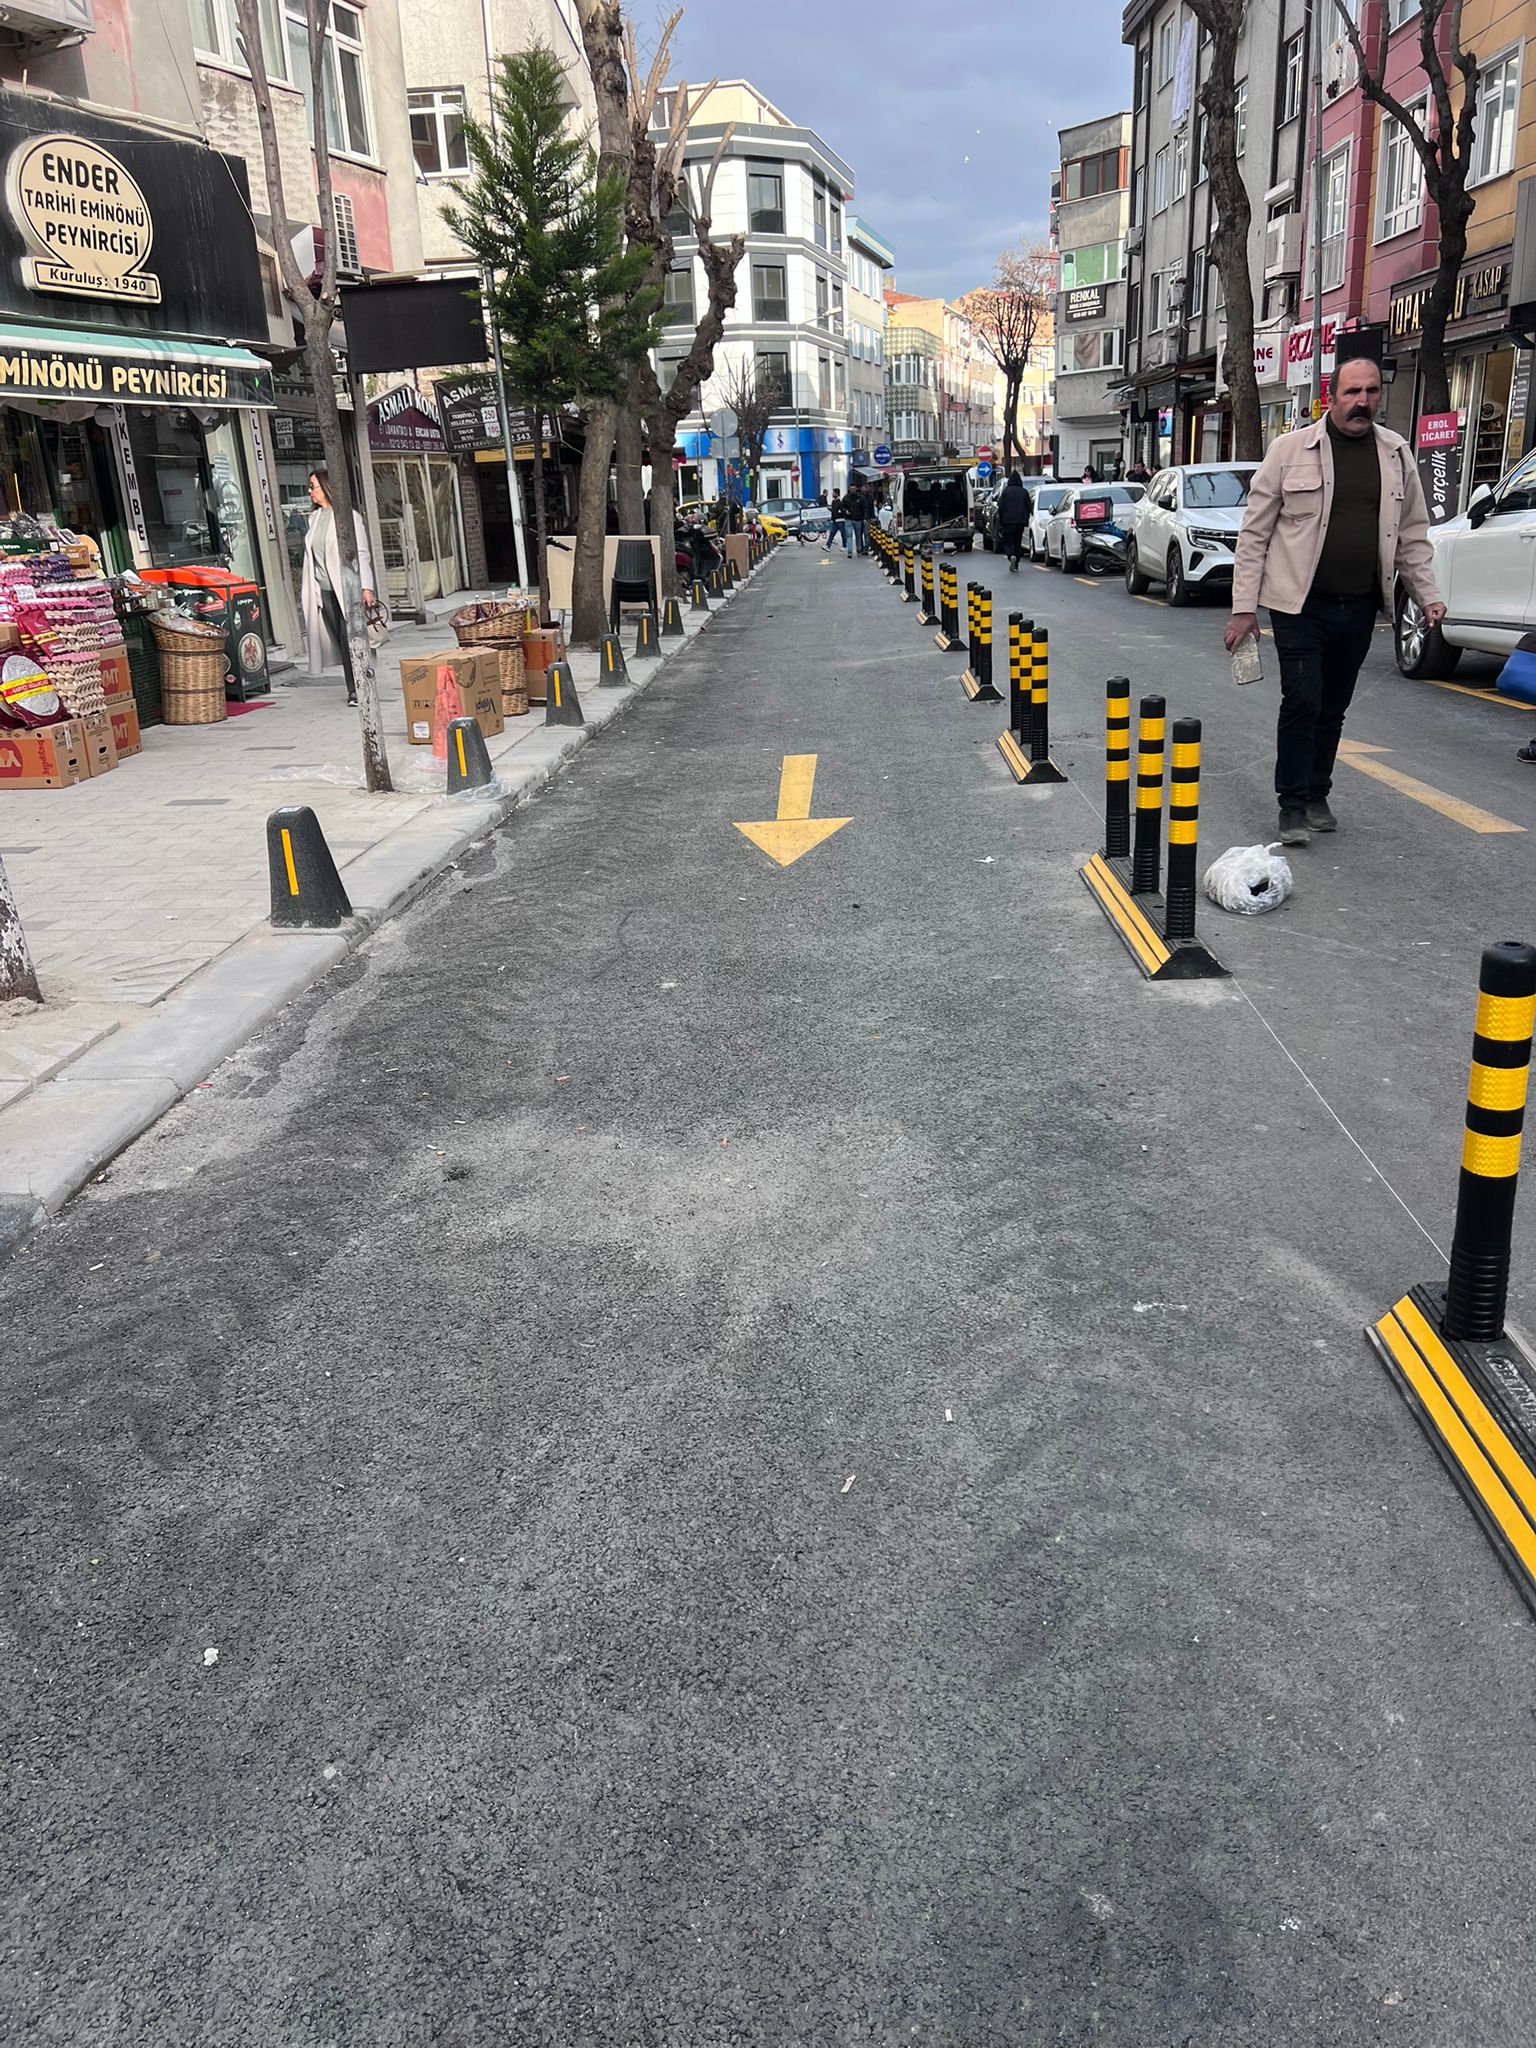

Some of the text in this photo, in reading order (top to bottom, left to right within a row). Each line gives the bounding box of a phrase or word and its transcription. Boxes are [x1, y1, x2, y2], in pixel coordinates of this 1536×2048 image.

[42, 153, 120, 195] ENDER
[24, 188, 144, 227] TARİHİ EMİNÖNÜ
[45, 221, 139, 256] PEYNİRCİSİ
[50, 268, 146, 291] Kuruluş: 1940
[1070, 288, 1100, 304] RENKAL
[1472, 265, 1502, 299] KASAP
[1288, 321, 1336, 363] ECZNE
[112, 364, 227, 398] PEYNİRCİSİ
[378, 387, 412, 427] ASMALI
[1427, 419, 1449, 430] EROL
[1420, 430, 1455, 443] TİCARET
[1432, 449, 1450, 503] arçelik
[261, 478, 275, 535] PAÇA
